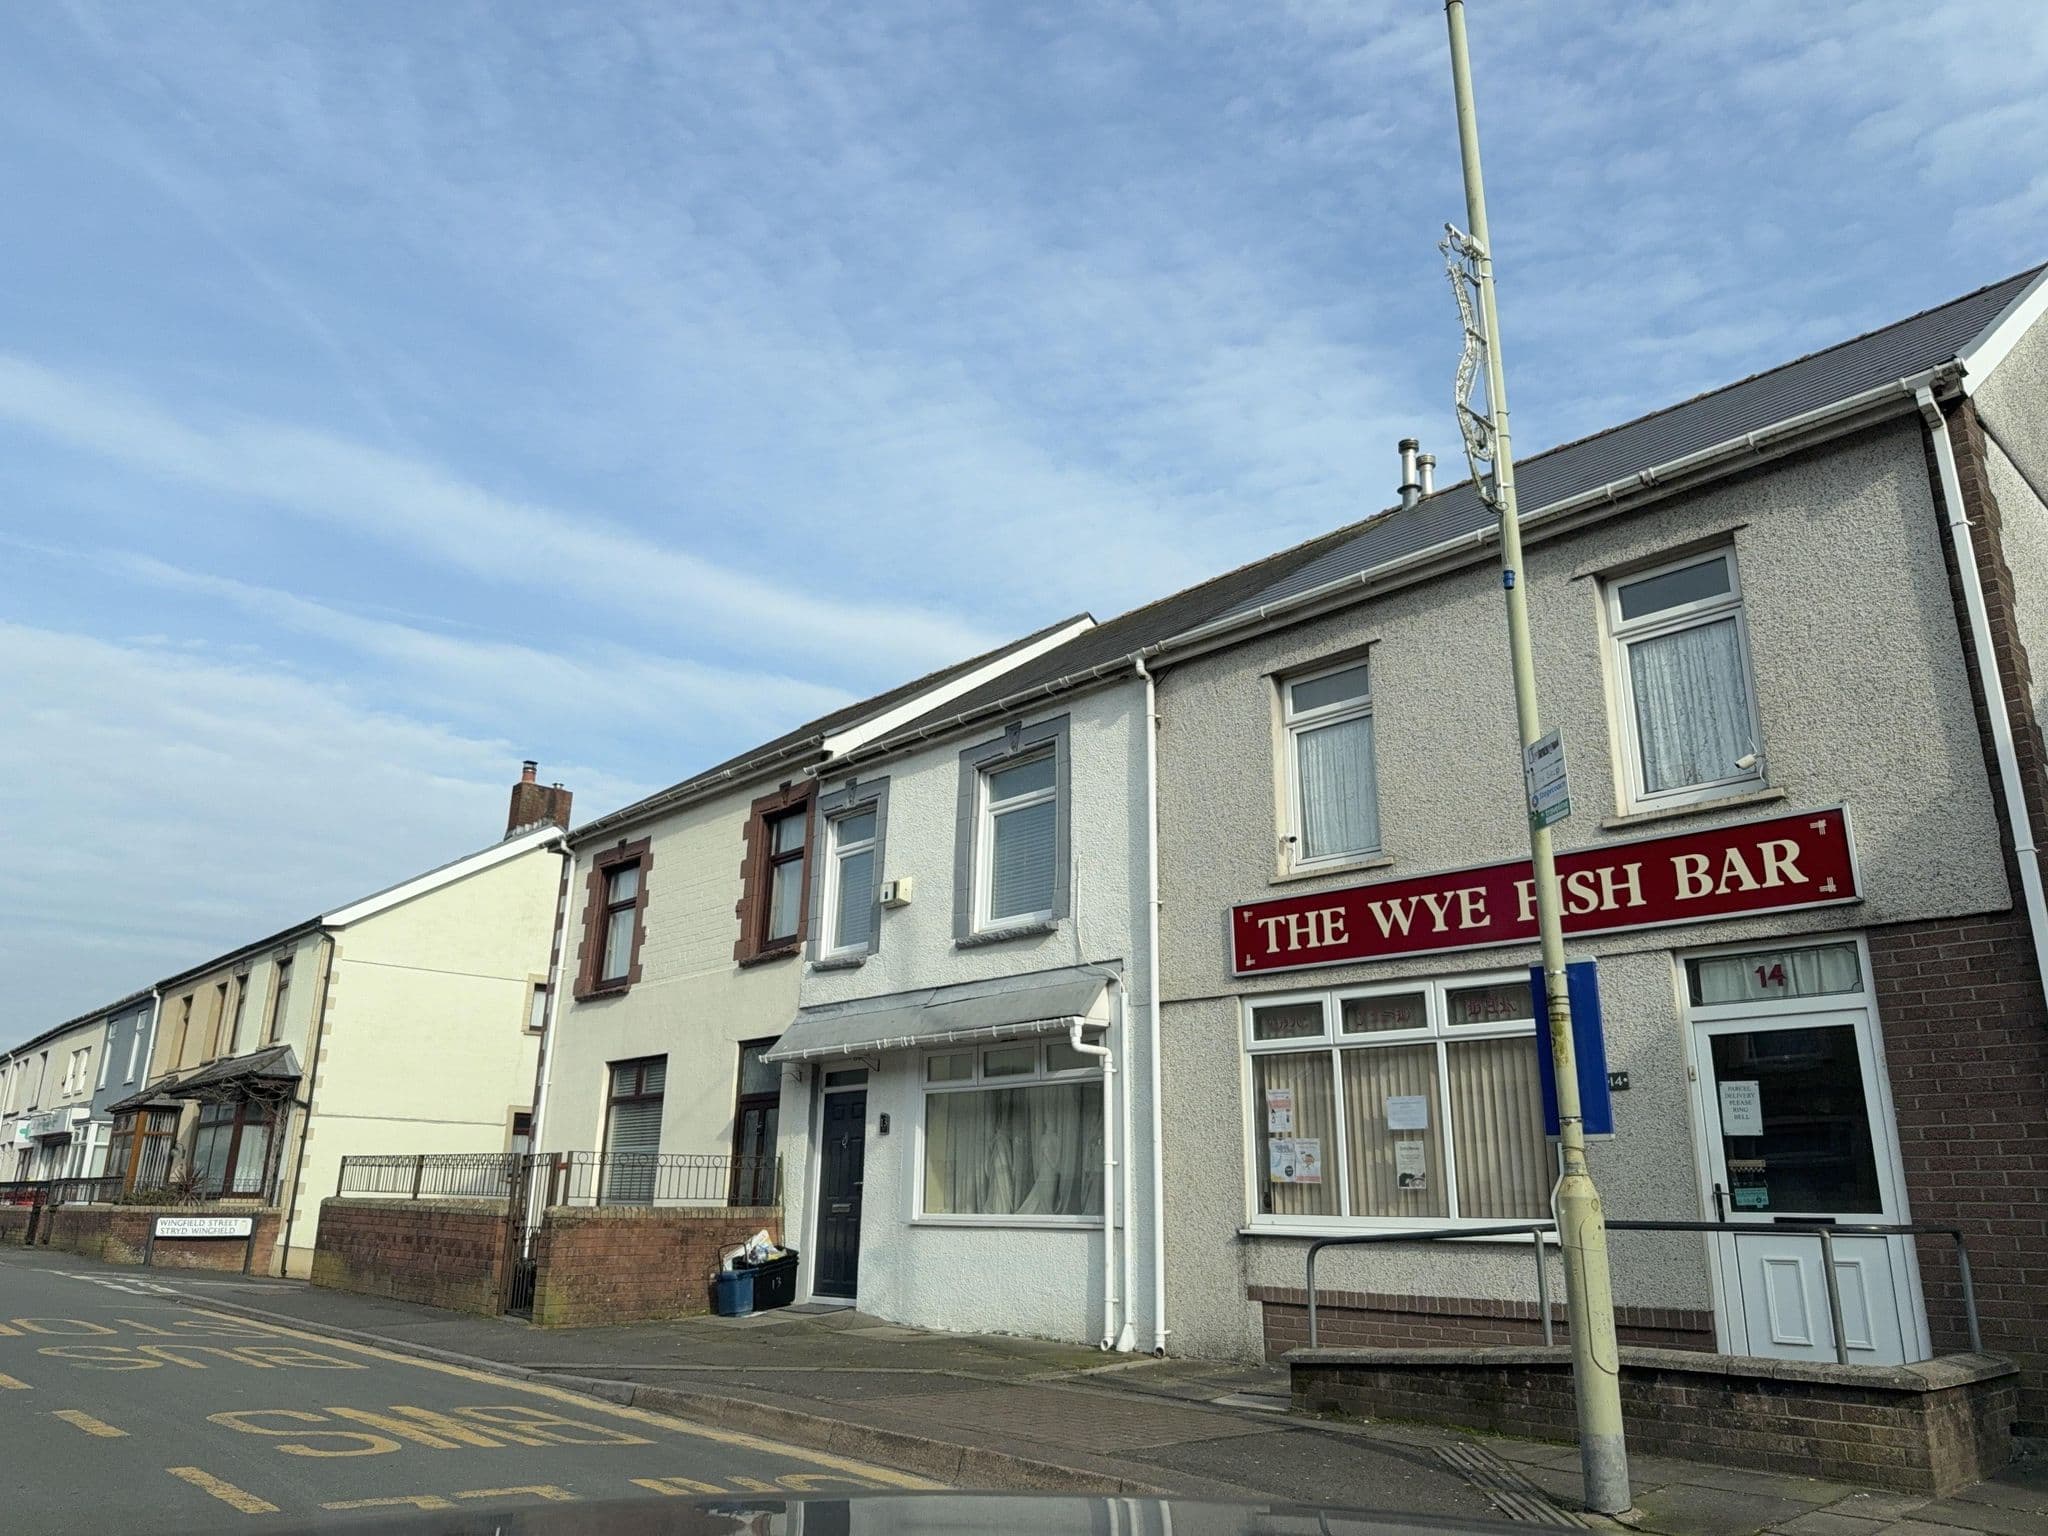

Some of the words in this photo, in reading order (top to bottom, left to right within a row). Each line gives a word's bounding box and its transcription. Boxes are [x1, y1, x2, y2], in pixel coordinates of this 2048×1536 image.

[1258, 906, 1349, 954] THE
[1367, 886, 1491, 939] WYE
[1671, 838, 1809, 901] BAR
[1754, 963, 1787, 988] 14
[160, 1219, 206, 1227] WINGFIELD
[207, 1219, 238, 1227] STREET
